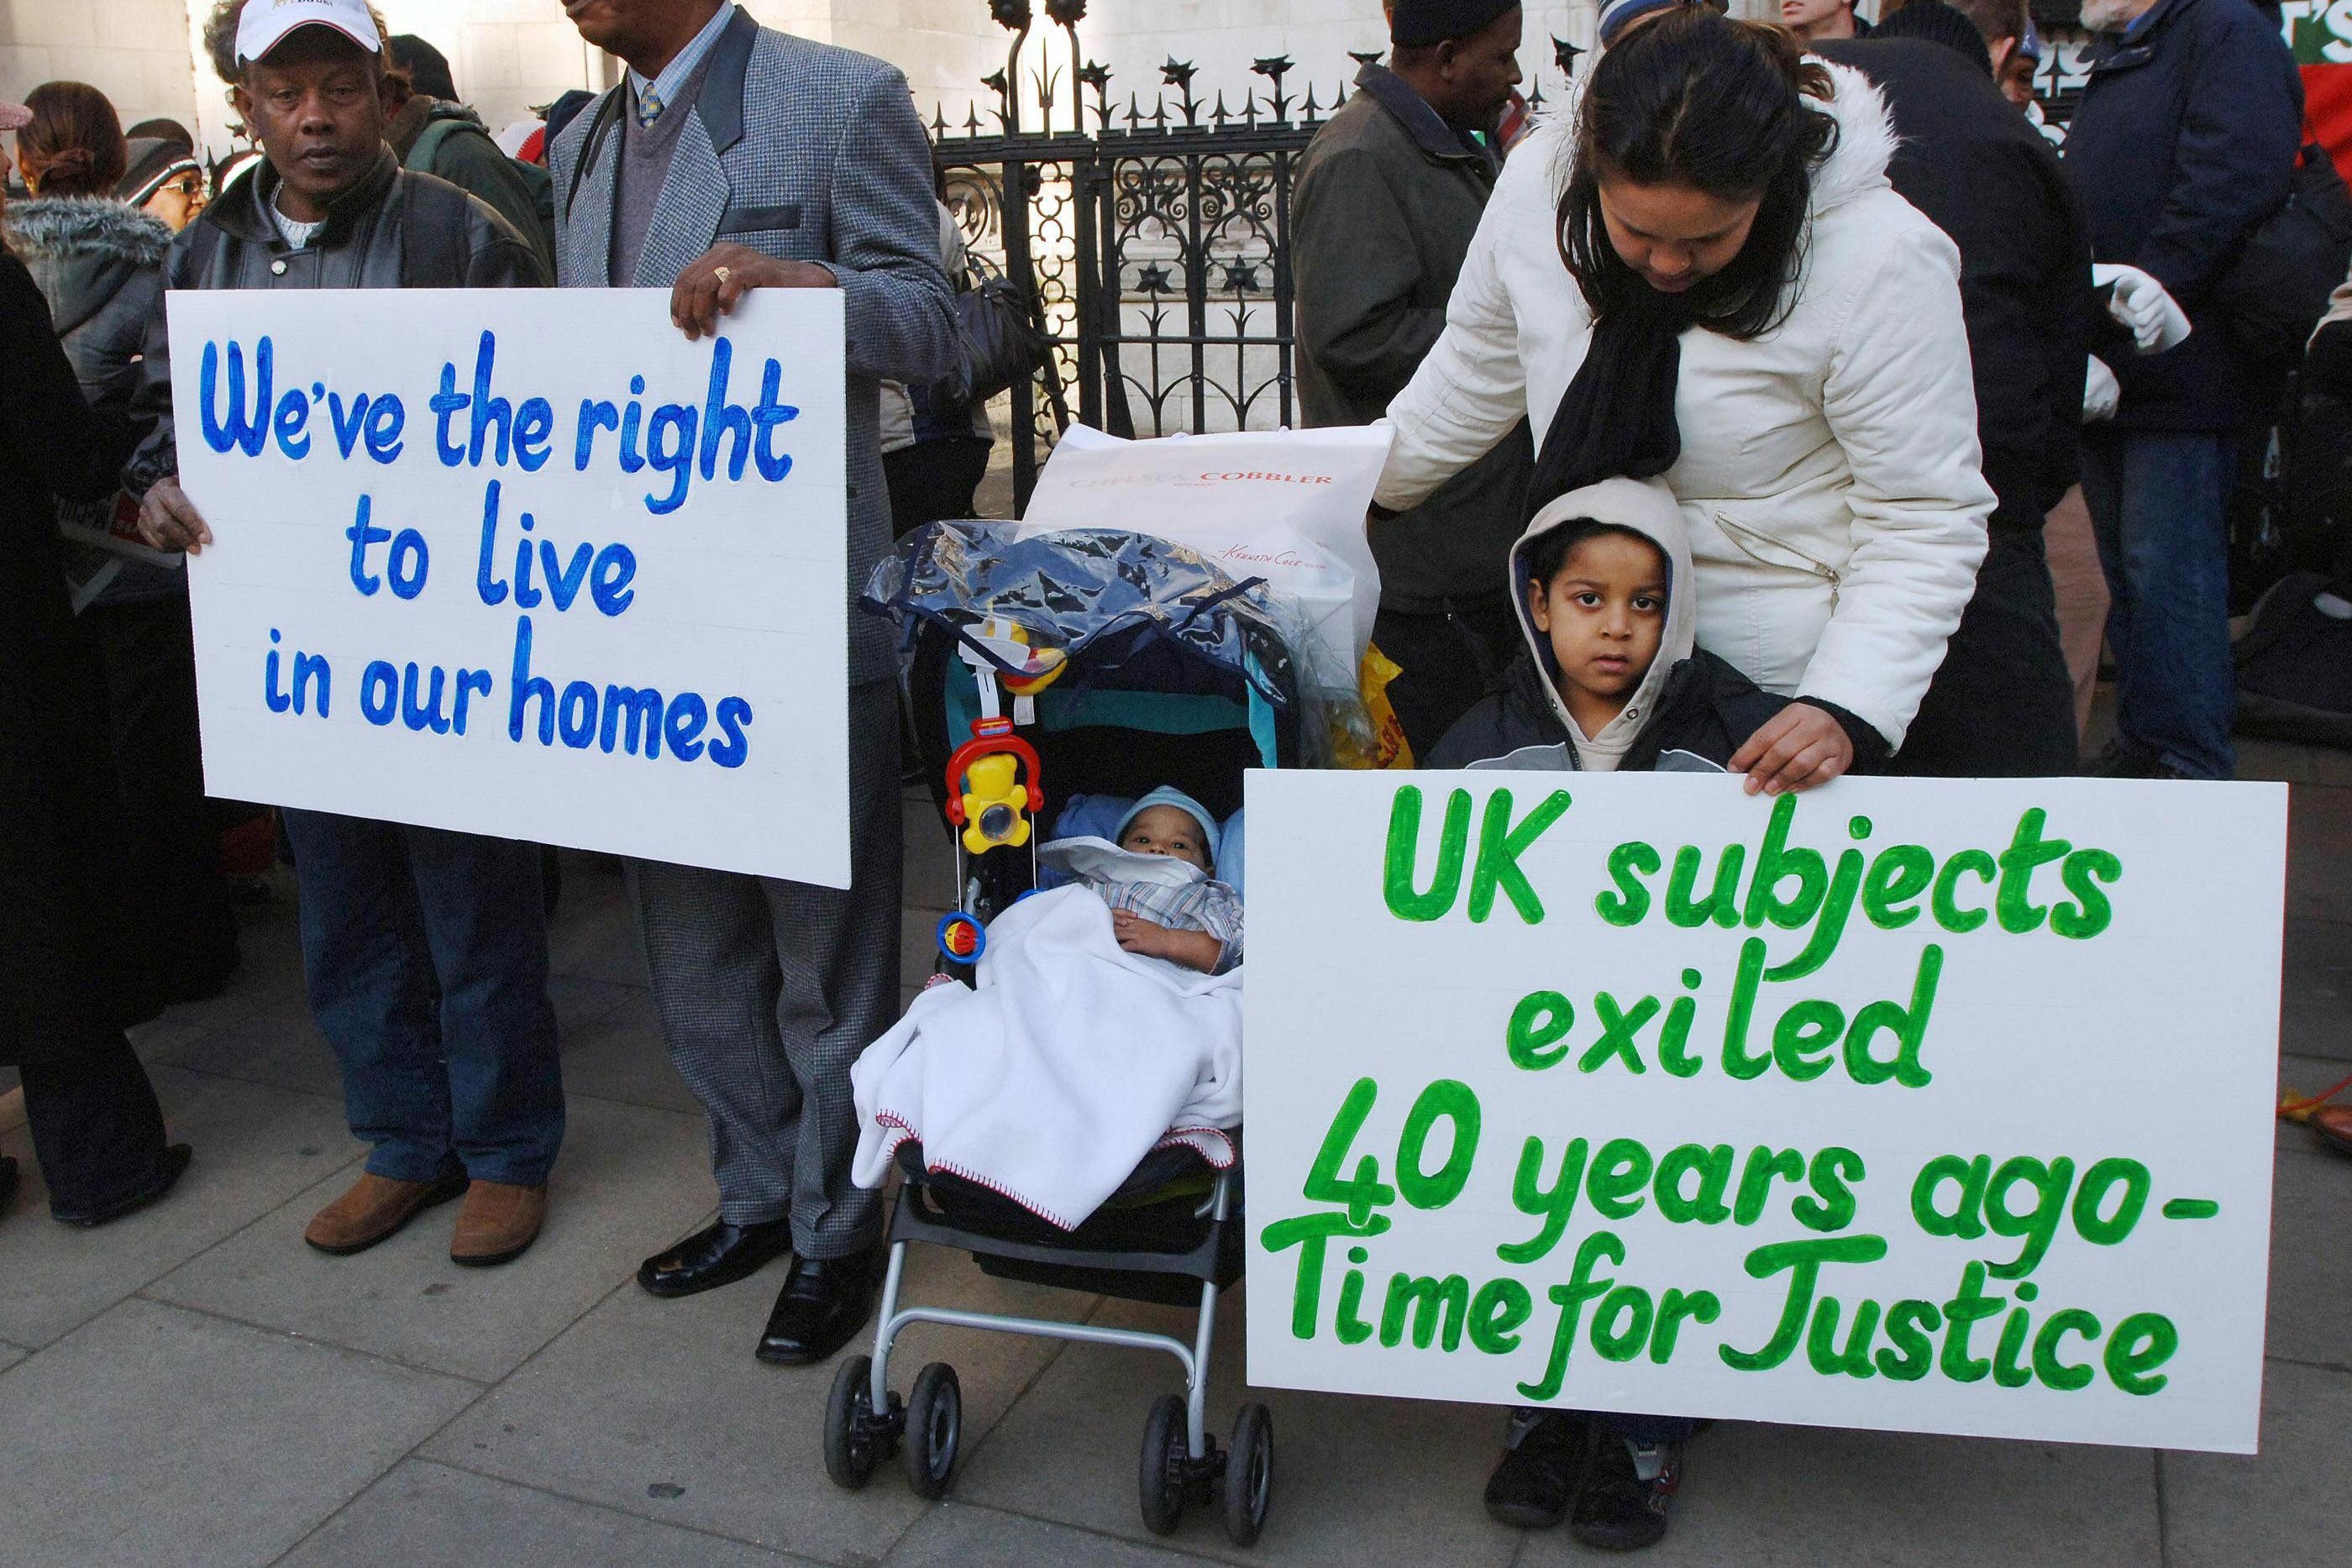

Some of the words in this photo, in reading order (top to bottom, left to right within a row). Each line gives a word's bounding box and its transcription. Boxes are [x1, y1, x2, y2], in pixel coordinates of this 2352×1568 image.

[200, 336, 405, 464] We've
[429, 330, 553, 472] the
[575, 337, 799, 515] right
[1200, 471, 1333, 485] COBBLER
[346, 495, 428, 600] to
[477, 480, 636, 616] live
[265, 628, 331, 718] in
[360, 661, 492, 736] our
[508, 616, 753, 768] homes
[1383, 785, 1572, 925] UK
[1595, 792, 2123, 982] subjects
[1506, 937, 1945, 1089] exiled
[1303, 1077, 1482, 1227] 40
[1497, 1136, 1866, 1265] years
[1260, 1212, 1532, 1354] Time
[1517, 1231, 1722, 1401] for
[1719, 1235, 2180, 1397] Justice
